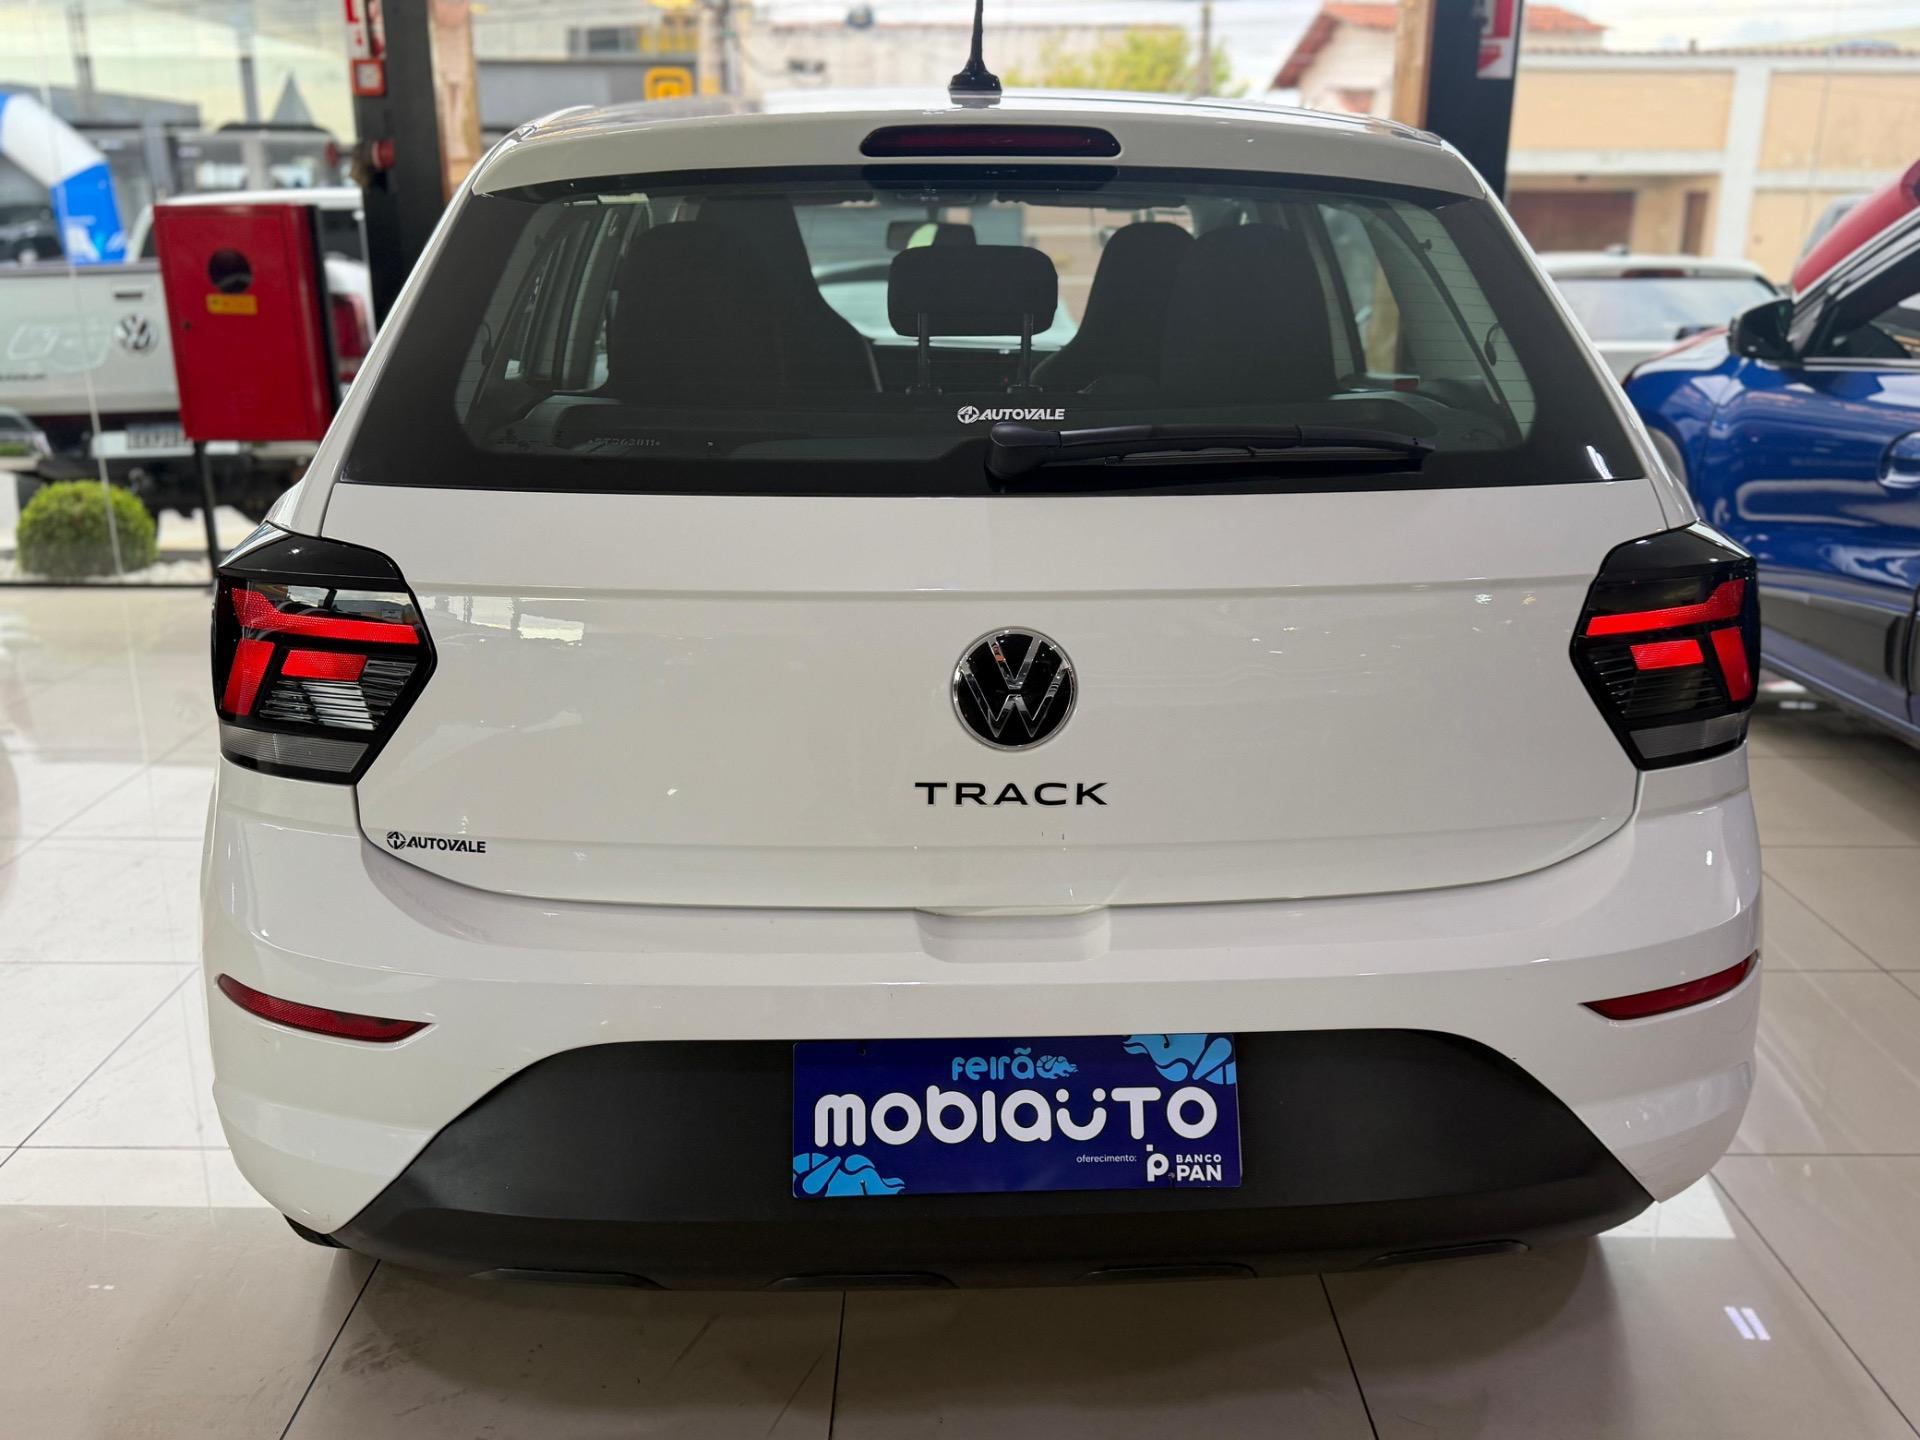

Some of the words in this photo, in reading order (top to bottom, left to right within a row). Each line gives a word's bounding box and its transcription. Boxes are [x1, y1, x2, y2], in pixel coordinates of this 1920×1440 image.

[979, 408, 1065, 420] AUTOVALE
[915, 783, 1108, 805] TRACK
[407, 836, 486, 853] AUTOVALE
[1076, 1154, 1137, 1163] oferecimento:
[1176, 1154, 1222, 1163] BANCO
[1177, 1165, 1222, 1181] PAN
